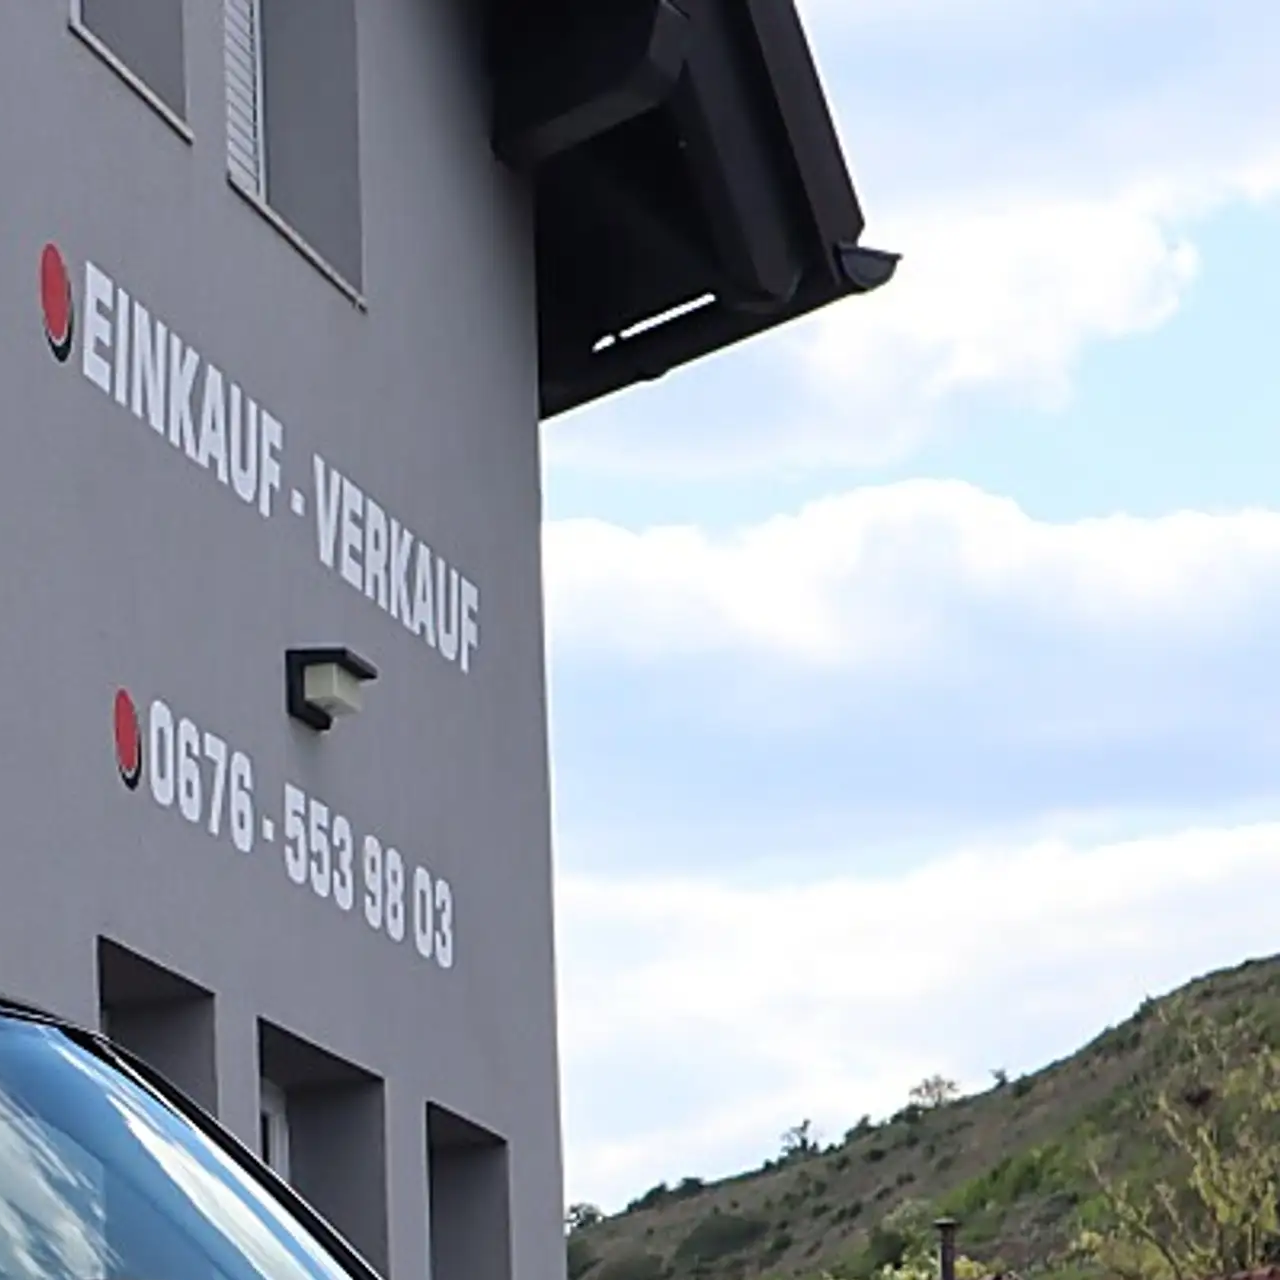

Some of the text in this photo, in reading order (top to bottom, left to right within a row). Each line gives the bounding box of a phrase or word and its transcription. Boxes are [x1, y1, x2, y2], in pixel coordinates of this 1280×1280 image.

[83, 261, 284, 518] EINKAUF
[312, 453, 480, 674] VERKAUF
[148, 699, 254, 854] 0676
[283, 782, 354, 912] 553
[362, 834, 405, 942] 98
[413, 865, 453, 969] 03
